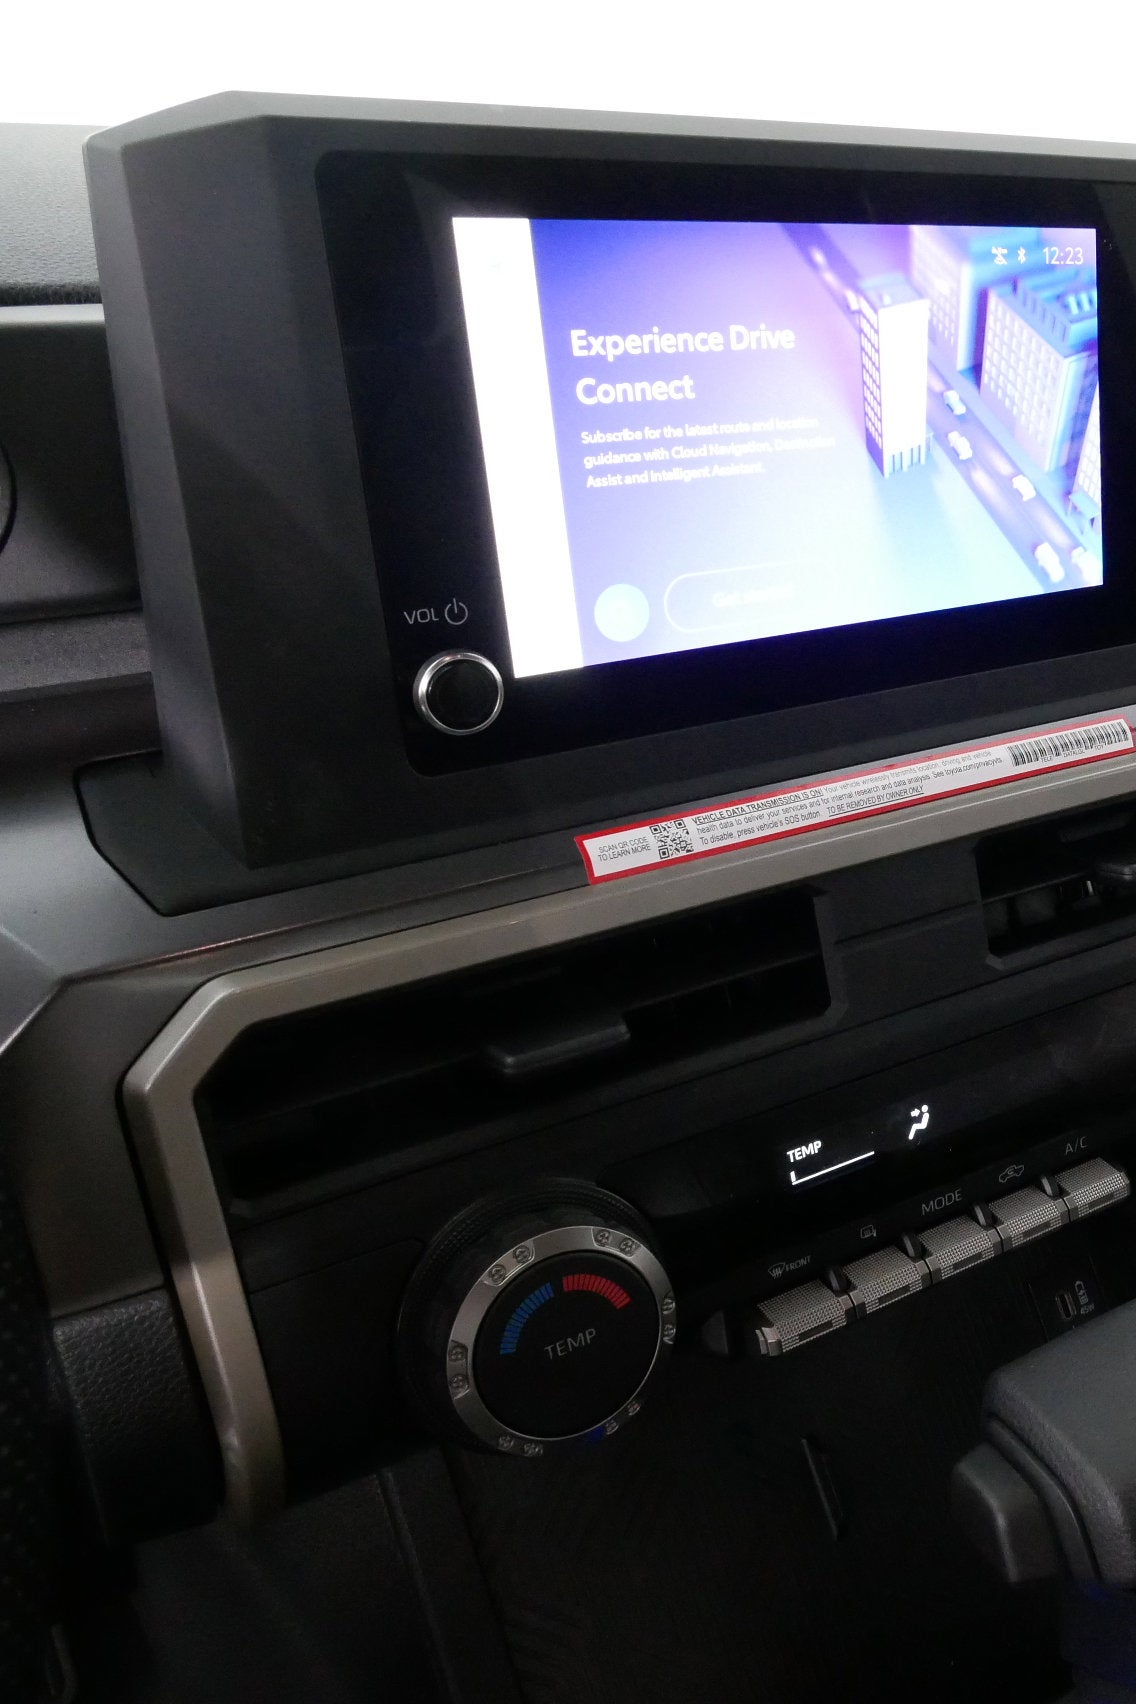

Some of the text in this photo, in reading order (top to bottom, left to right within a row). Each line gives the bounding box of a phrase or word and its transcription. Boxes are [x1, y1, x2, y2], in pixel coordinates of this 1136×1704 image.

[1042, 246, 1084, 265] 12:23
[570, 323, 796, 362] Experience Drive
[575, 375, 696, 405] Connect
[581, 428, 643, 445] Subscribe
[645, 426, 661, 440] for
[663, 425, 683, 439] the
[685, 423, 719, 436] latest
[720, 421, 750, 435] route
[583, 450, 642, 470] guidance
[643, 448, 669, 462] with
[671, 445, 707, 460] Cloud
[586, 474, 622, 488] Assist
[624, 472, 649, 486] and
[650, 466, 710, 483] Intelligent
[404, 608, 439, 624] VOL
[691, 812, 724, 824] VEHICLE
[726, 807, 747, 817] DATA
[747, 794, 801, 811] TRANSMISSION
[802, 791, 809, 799] IS
[697, 823, 718, 834] health
[719, 820, 734, 830] data
[735, 817, 743, 825] to
[743, 813, 765, 824] deliver
[766, 810, 780, 820] your
[781, 804, 808, 814] services
[809, 800, 821, 809] and
[854, 785, 881, 797] research
[881, 782, 893, 790] and
[700, 836, 709, 846] To
[736, 826, 756, 838] press
[756, 819, 783, 832] vehicle's
[784, 813, 800, 824] SOS
[827, 805, 836, 815] TO
[837, 803, 846, 812] BE
[846, 797, 877, 810] REMOVED
[876, 794, 886, 803] BY
[885, 788, 908, 800] OWNER
[908, 784, 924, 796] ONLY
[598, 836, 649, 854] SCAN QR CODE
[598, 843, 652, 863] TO LEARN MORE
[787, 1140, 822, 1163] TEMP
[1065, 1136, 1088, 1156] A/C
[921, 1188, 963, 1216] MODE
[785, 1255, 812, 1273] FRONT
[1080, 1303, 1095, 1314] 45W
[543, 1328, 596, 1360] TEMP
